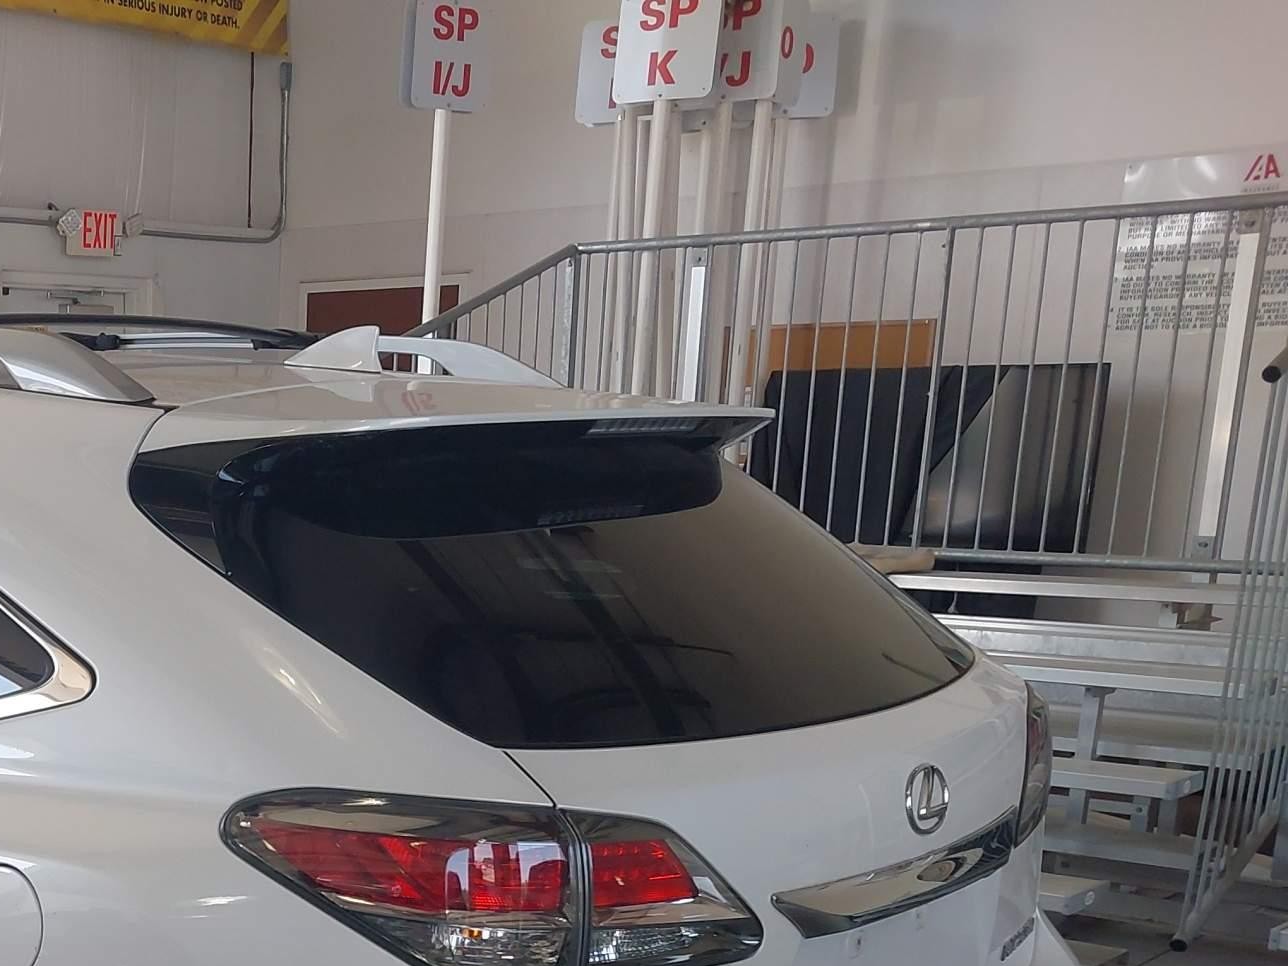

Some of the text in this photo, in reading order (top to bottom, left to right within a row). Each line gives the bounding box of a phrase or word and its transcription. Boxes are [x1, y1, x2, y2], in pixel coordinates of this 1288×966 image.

[158, 3, 193, 19] INJURY
[195, 9, 209, 22] OR
[210, 13, 241, 29] DEATH.
[432, 4, 479, 42] SP
[640, 0, 699, 31] SP
[723, 0, 762, 31] P
[432, 60, 472, 97] I/J
[647, 50, 678, 87] K
[82, 211, 118, 249] EXIT
